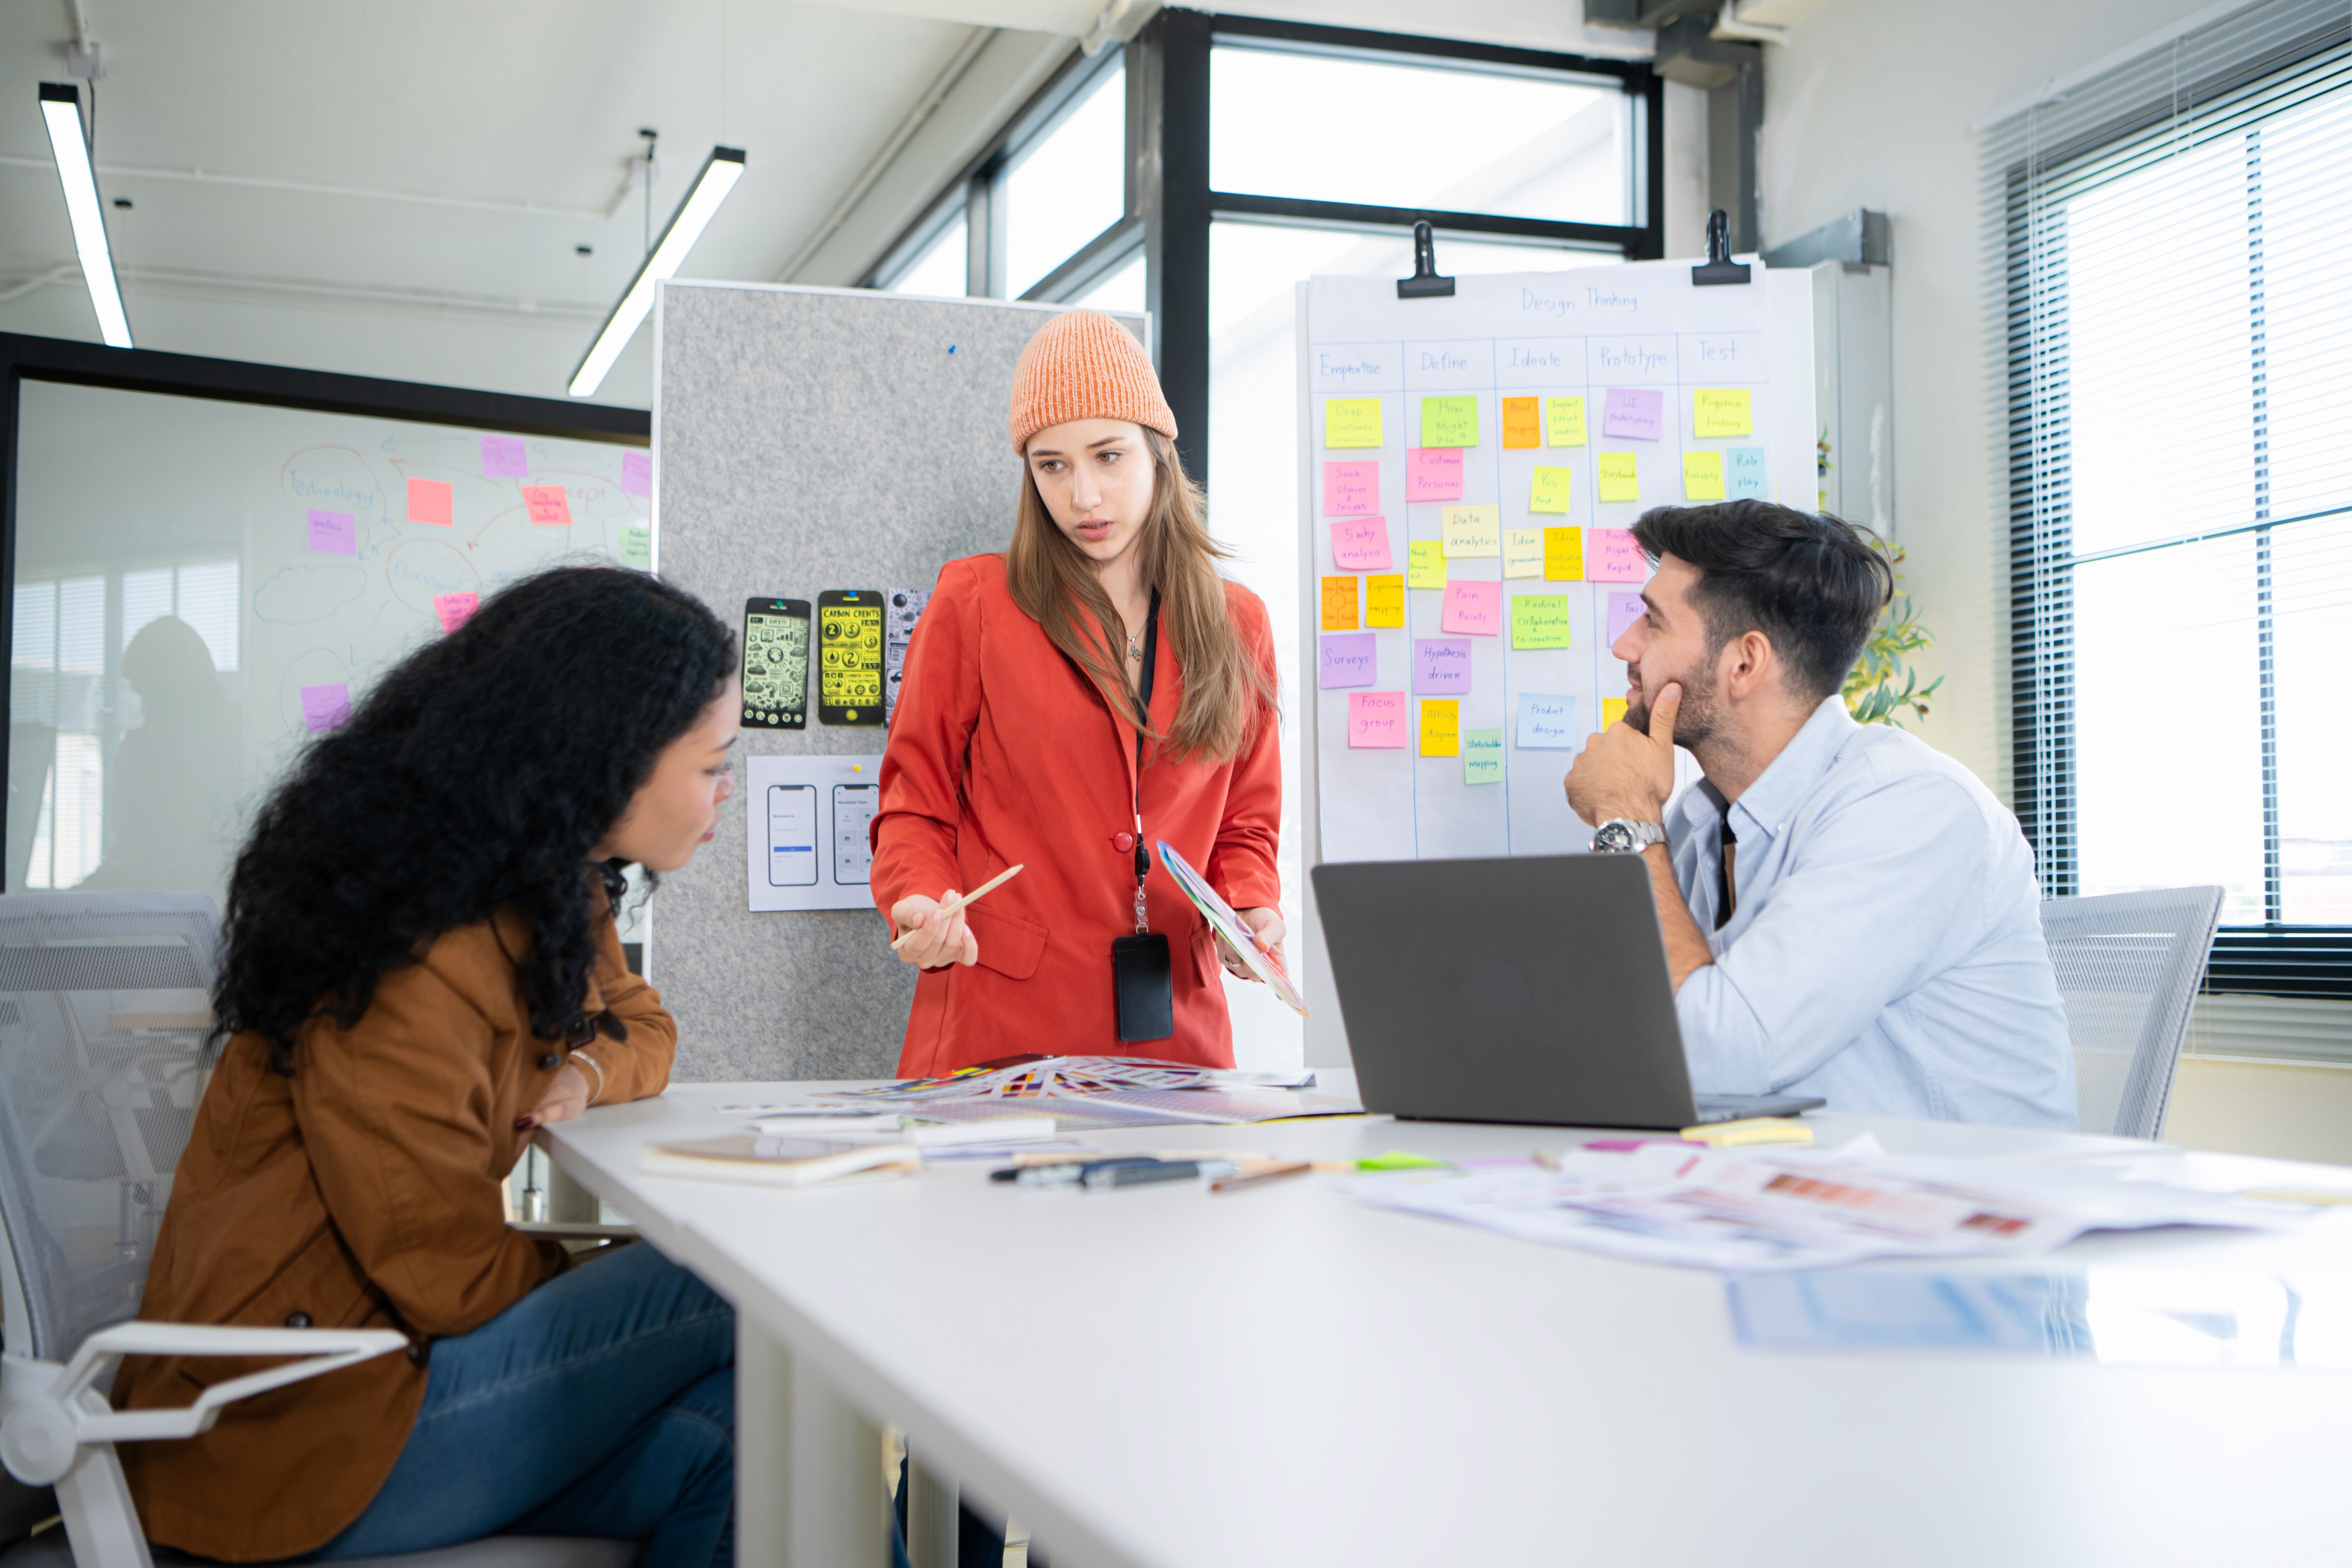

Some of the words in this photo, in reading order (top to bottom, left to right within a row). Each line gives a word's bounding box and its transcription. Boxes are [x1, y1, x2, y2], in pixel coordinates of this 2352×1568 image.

[1522, 287, 1575, 317] Design
[1585, 287, 1638, 313] Thinking
[1700, 339, 1738, 361] Test
[1421, 353, 1468, 371] Define
[1509, 347, 1561, 367] Ideate
[1600, 346, 1668, 374] Prototype
[1438, 400, 1463, 413] How
[1622, 397, 1637, 408] UI
[1336, 404, 1363, 418] Deep
[1437, 420, 1468, 433] Might
[1419, 452, 1460, 465] Customer
[1736, 454, 1758, 467] Role
[1336, 467, 1361, 479] Seek
[1418, 477, 1459, 489] Personas
[1541, 472, 1557, 488] Yes
[1738, 477, 1759, 490] play
[288, 469, 373, 509] Technology
[1534, 495, 1552, 505] And
[1452, 513, 1481, 525] Data
[1345, 528, 1353, 541] 5
[1356, 526, 1376, 543] why
[1450, 533, 1498, 548] analytics
[1511, 533, 1535, 546] Idea
[1552, 532, 1575, 542] Idea
[1341, 548, 1380, 562] analysis
[1606, 545, 1630, 556] Right
[1607, 562, 1631, 575] Rapid
[1456, 587, 1478, 599] Pain
[1525, 599, 1561, 609] Radical
[1626, 602, 1643, 614] Fail
[823, 609, 850, 618] CARBON
[853, 610, 880, 618] CREDITS
[1459, 611, 1486, 622] Points
[829, 625, 835, 634] 2
[847, 652, 855, 664] 2
[1324, 648, 1369, 671] Surveys
[1424, 646, 1466, 662] Hypothesis
[1428, 667, 1460, 680] driven
[1362, 696, 1395, 708] Focus
[1531, 703, 1564, 715] Product
[1427, 710, 1457, 722] Affinity
[1357, 719, 1394, 733] group
[1533, 723, 1565, 738] design
[1426, 729, 1457, 742] diagram
